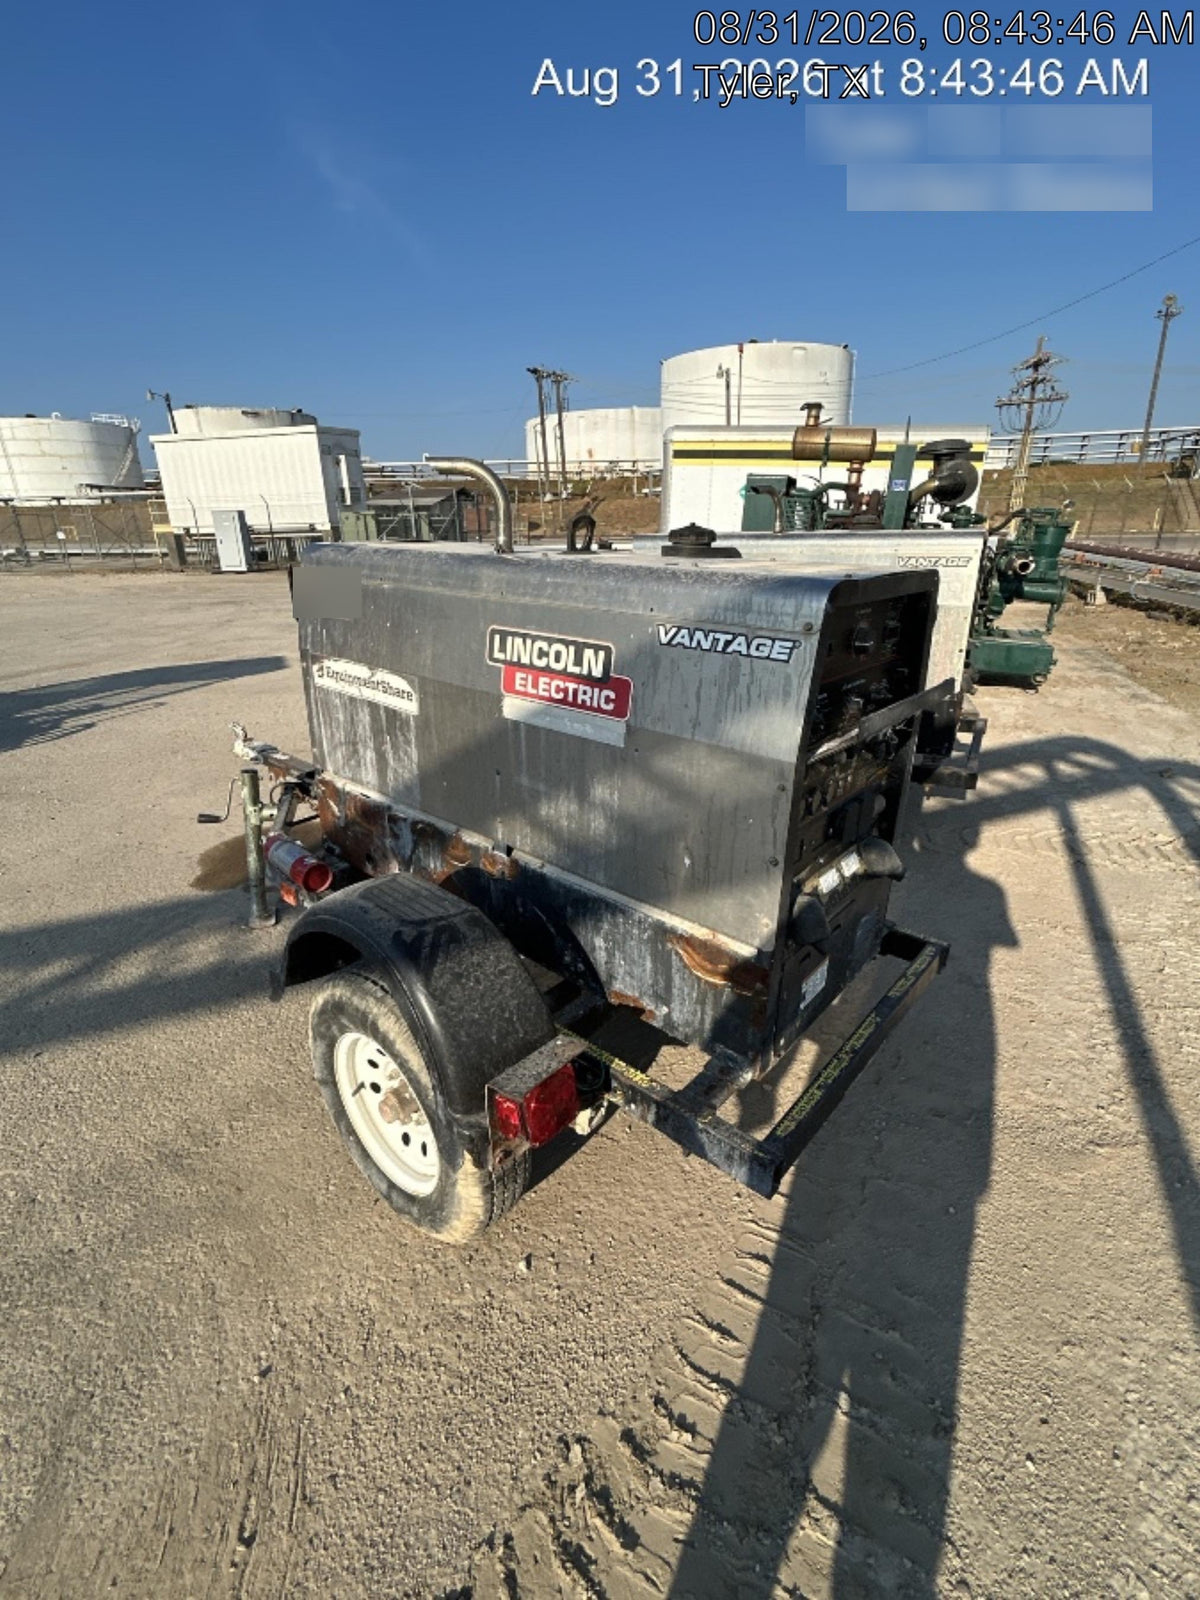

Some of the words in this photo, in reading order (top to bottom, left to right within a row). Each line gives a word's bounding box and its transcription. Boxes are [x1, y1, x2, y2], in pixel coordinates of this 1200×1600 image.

[897, 555, 973, 569] VANTAGE
[493, 633, 606, 678] LINCOLN
[657, 624, 797, 663] VANTAGE
[514, 671, 616, 711] ELECTRIC
